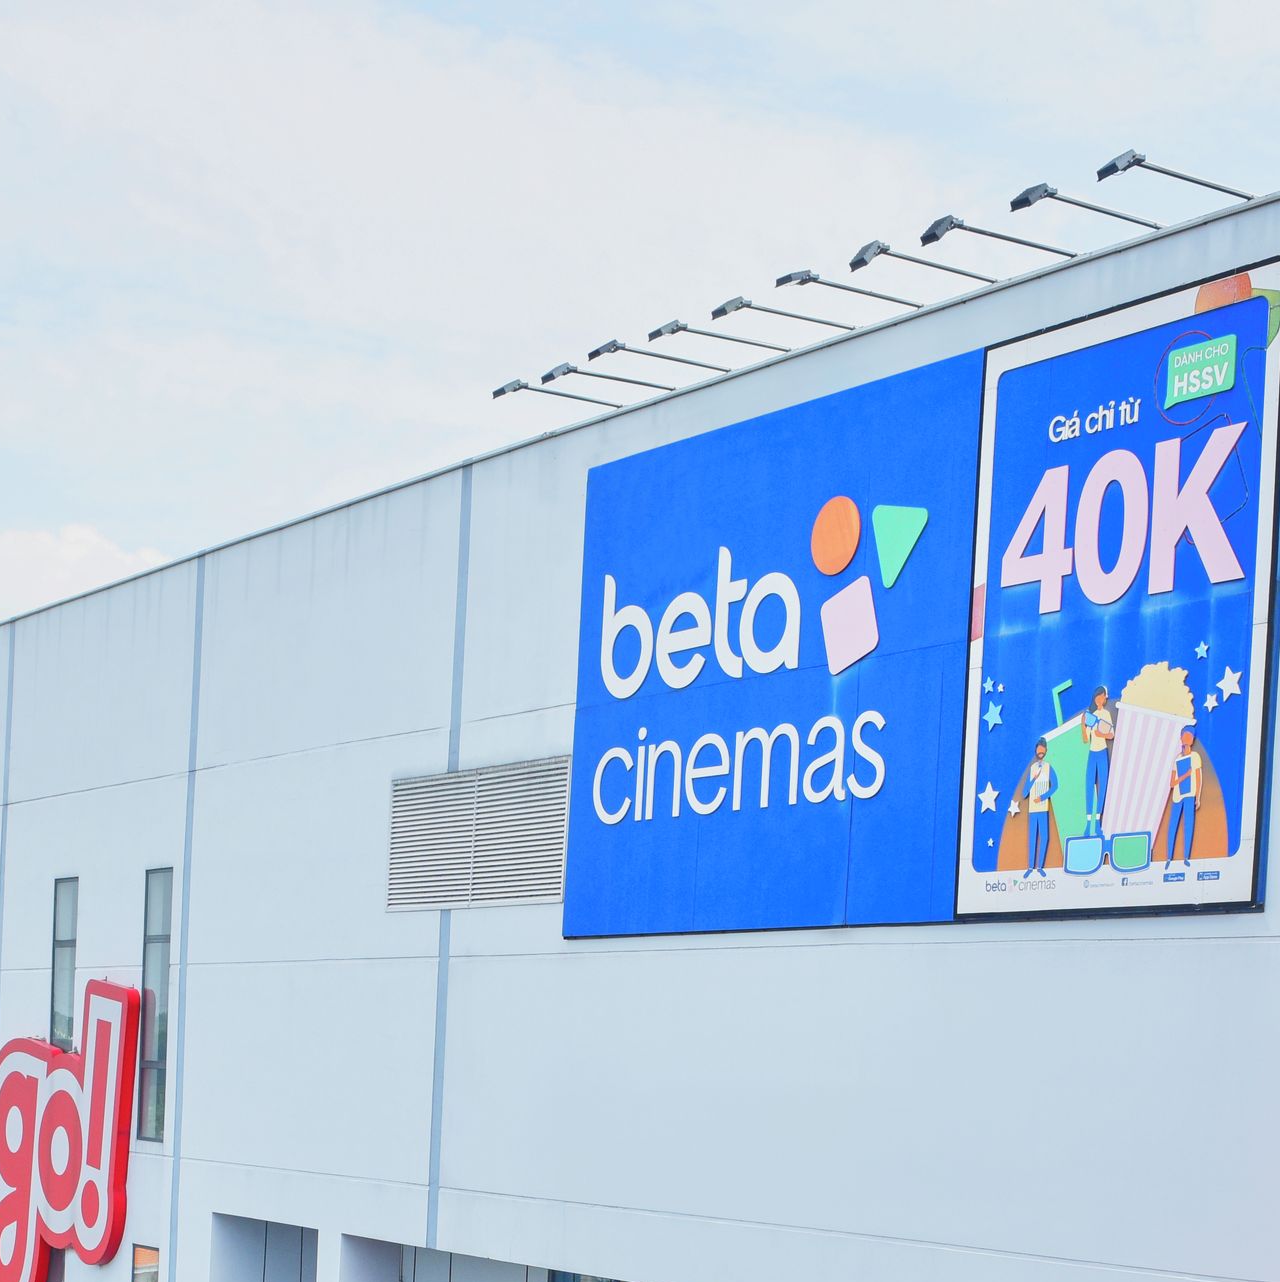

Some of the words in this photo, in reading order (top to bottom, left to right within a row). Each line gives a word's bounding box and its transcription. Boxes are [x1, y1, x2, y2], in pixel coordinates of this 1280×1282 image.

[1174, 350, 1203, 368] DÀNH
[1204, 343, 1229, 360] CHO
[1173, 361, 1229, 398] HSSV
[1048, 410, 1081, 443] Giá
[1085, 400, 1115, 435] chỉ
[1118, 397, 1142, 427] từ
[1000, 421, 1247, 615] 40K
[600, 545, 801, 700] beta
[593, 710, 886, 826] cinemas
[985, 880, 1007, 892] beta
[1018, 879, 1056, 891] cinemas
